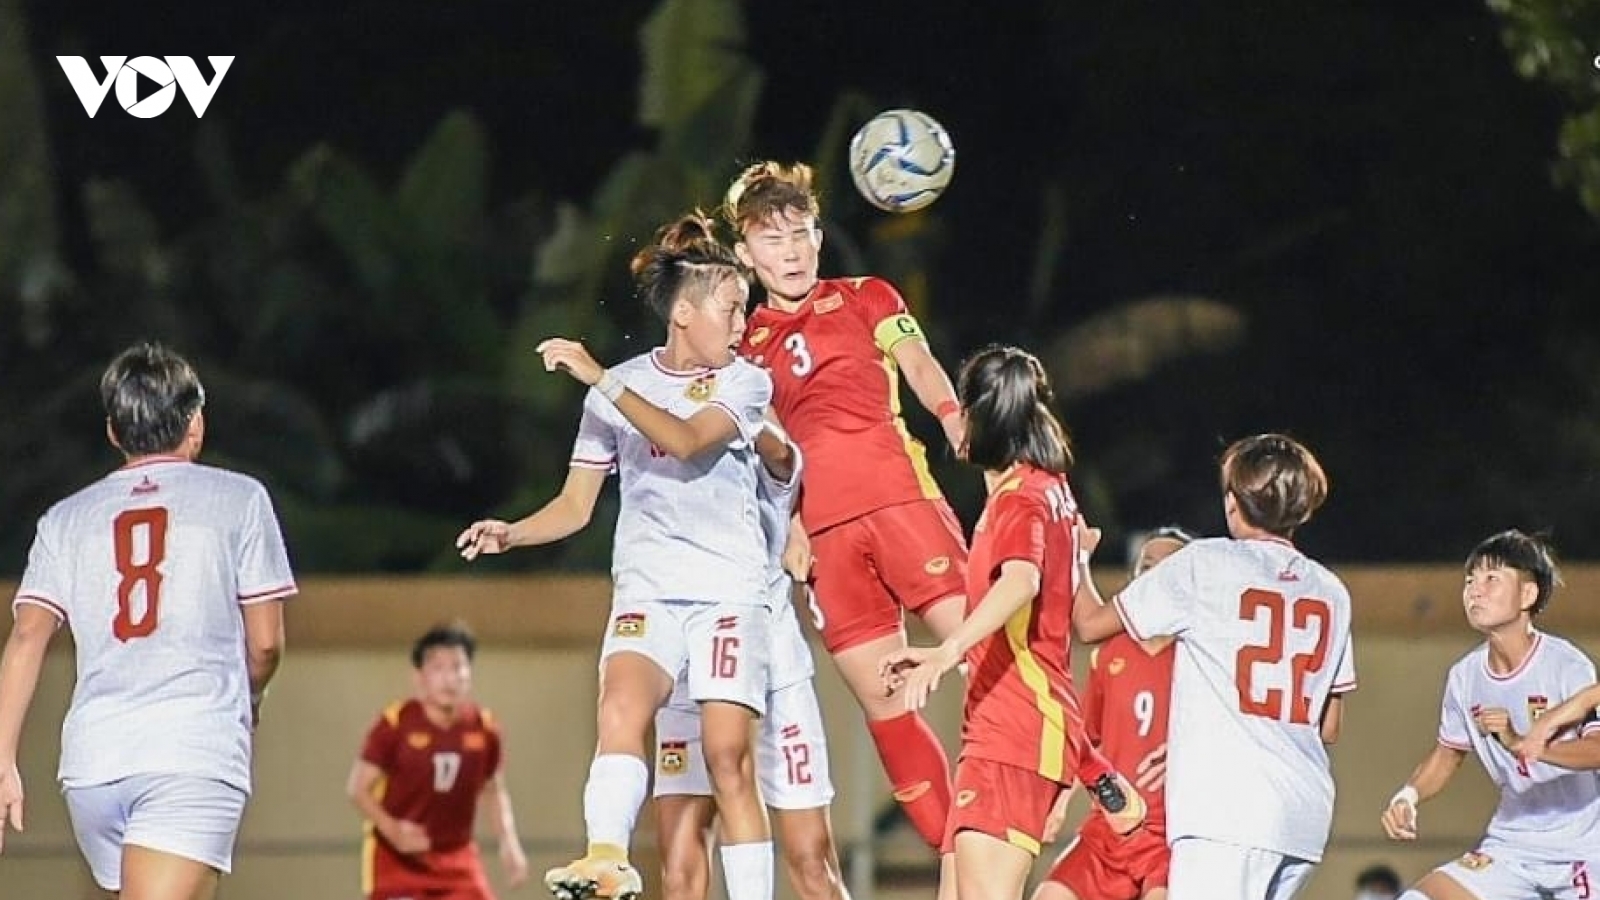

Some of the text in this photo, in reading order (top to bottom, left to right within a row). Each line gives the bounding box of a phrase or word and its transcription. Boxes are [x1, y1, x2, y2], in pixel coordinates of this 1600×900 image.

[896, 317, 914, 333] C
[784, 332, 812, 377] 3
[113, 506, 169, 643] 8
[711, 636, 740, 679] 16
[1236, 587, 1331, 724] 22
[1134, 690, 1155, 737] 9
[781, 743, 812, 785] 12
